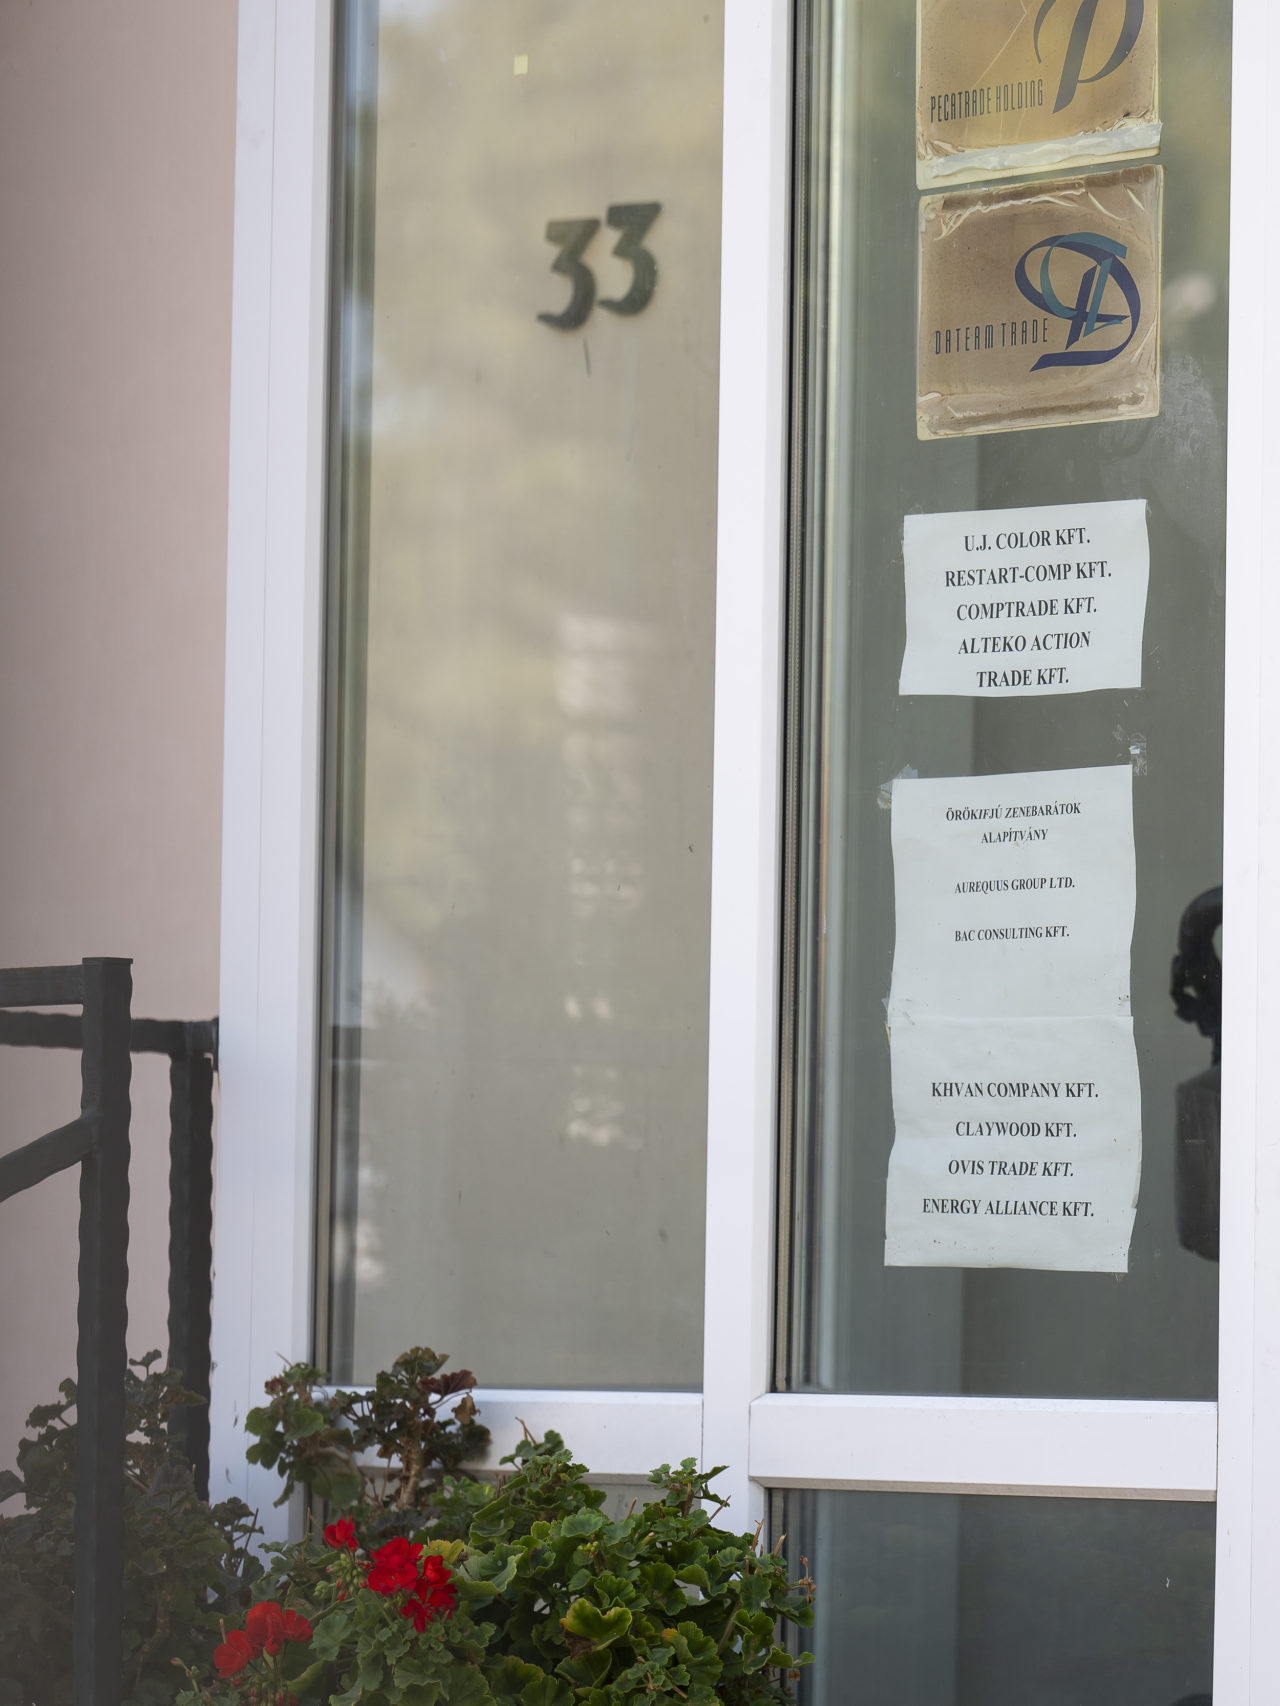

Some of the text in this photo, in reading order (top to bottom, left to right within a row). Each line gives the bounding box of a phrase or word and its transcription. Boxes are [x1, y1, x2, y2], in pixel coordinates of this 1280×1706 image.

[996, 79, 1043, 113] HOLDING
[536, 201, 663, 332] 33
[935, 318, 1048, 355] DATEAM TRADE
[964, 528, 1090, 551] U.J. COLOR KFT.
[945, 561, 1111, 587] RESTART-COMP KFT.
[957, 597, 1096, 621] COMPTRADE KFT.
[958, 631, 1090, 654] ALTEKO ACTION
[977, 667, 1068, 687] TRADE KFT.
[1005, 801, 1080, 818] ZENEBARÁTOK
[981, 827, 1049, 844] ALAPÍTVÁNY
[954, 877, 1075, 895] AUREQUUS GROUP LTD.
[955, 926, 1069, 942] BAC CONSULTING KFT.
[932, 1082, 1098, 1097] KHVAN COMPANY KFT.
[956, 1121, 1076, 1137] CLAYWOOD KFT.
[948, 1160, 1073, 1176] OVIS TRADE KFT.
[923, 1199, 1094, 1216] ENERGY ALLIANCE KFT.
